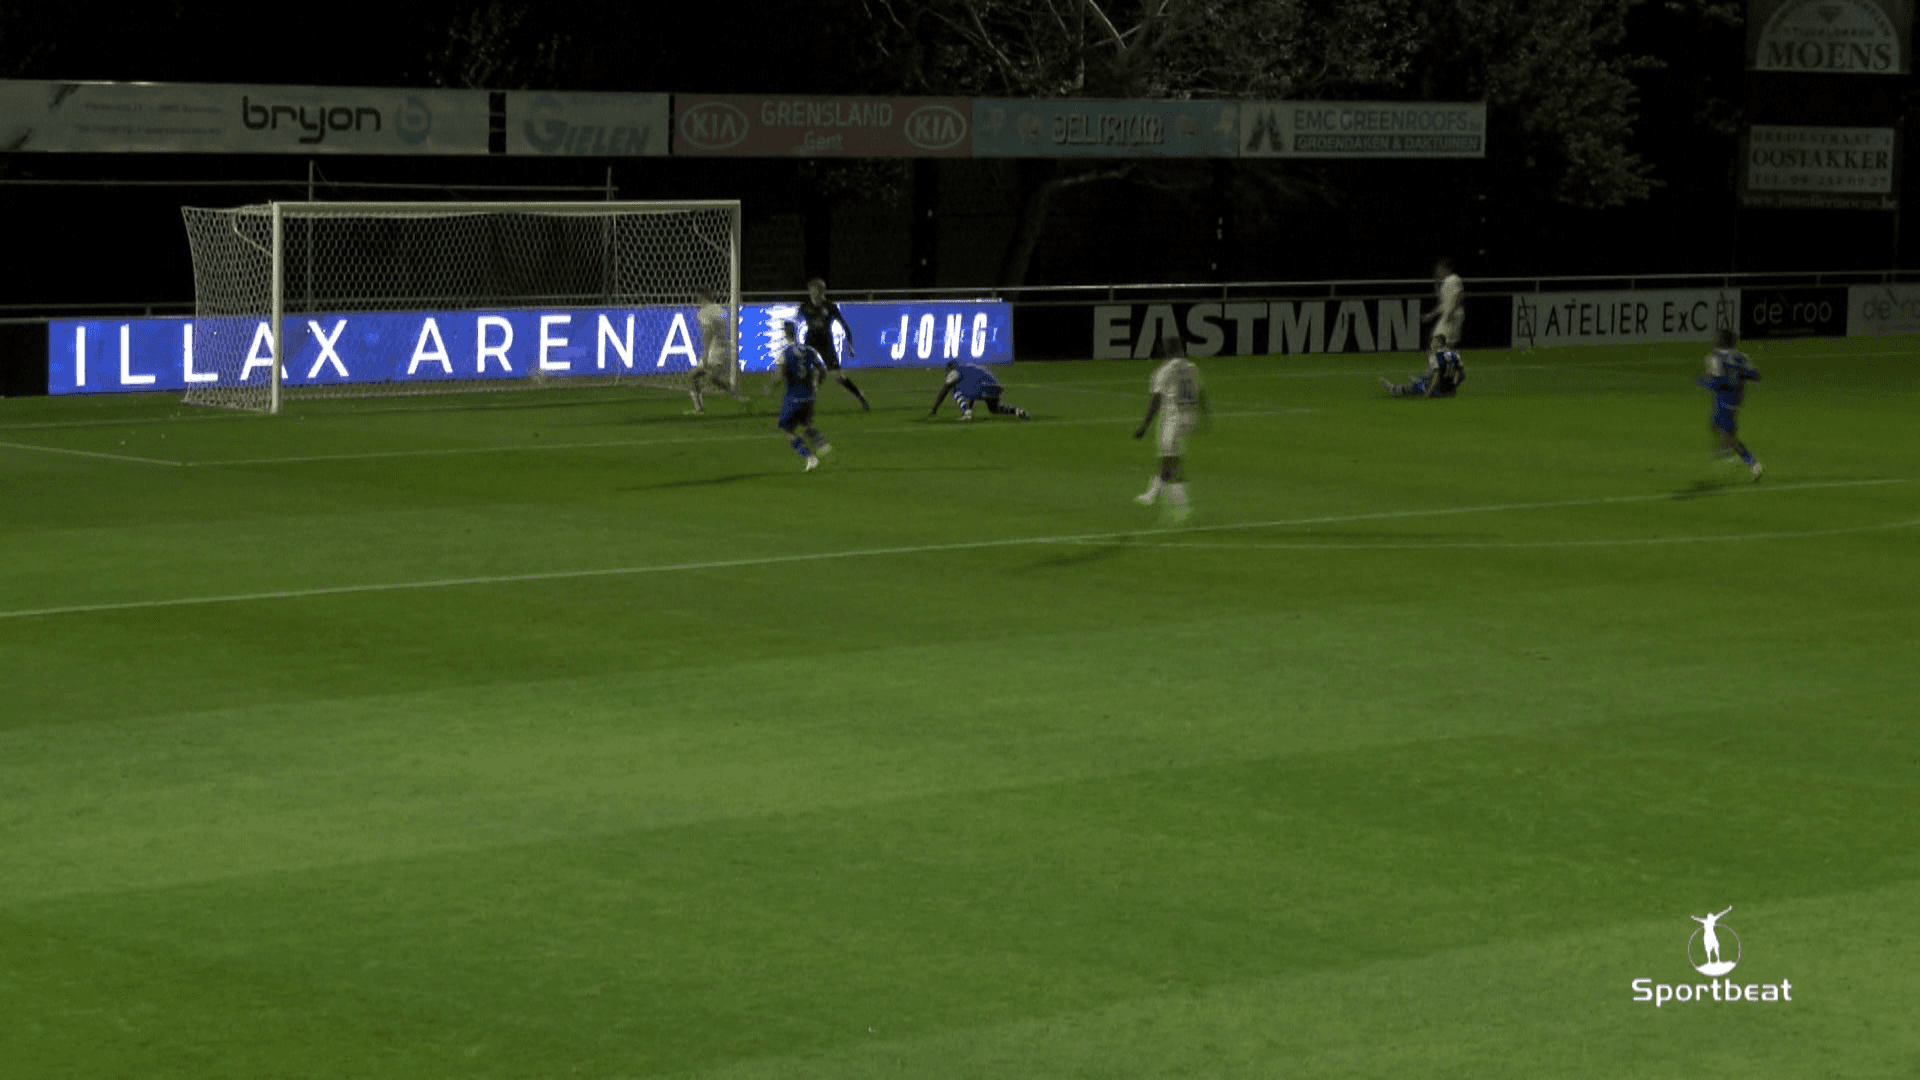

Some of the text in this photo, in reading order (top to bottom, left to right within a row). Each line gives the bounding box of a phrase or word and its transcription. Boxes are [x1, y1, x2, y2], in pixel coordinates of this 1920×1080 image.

[1768, 41, 1891, 71] MOENS
[242, 95, 382, 144] bryon
[692, 112, 738, 139] KIA
[761, 100, 894, 127] GRENSLAND
[914, 115, 958, 140] KIA
[1294, 109, 1337, 131] EMC
[1340, 109, 1468, 132] GREENROOFS
[1752, 148, 1888, 169] OOSTAKKER
[1092, 299, 1422, 360] EASTMAN
[1544, 300, 1709, 337] ATELIER ExC
[407, 312, 699, 375] ARENA
[890, 312, 989, 360] JONG
